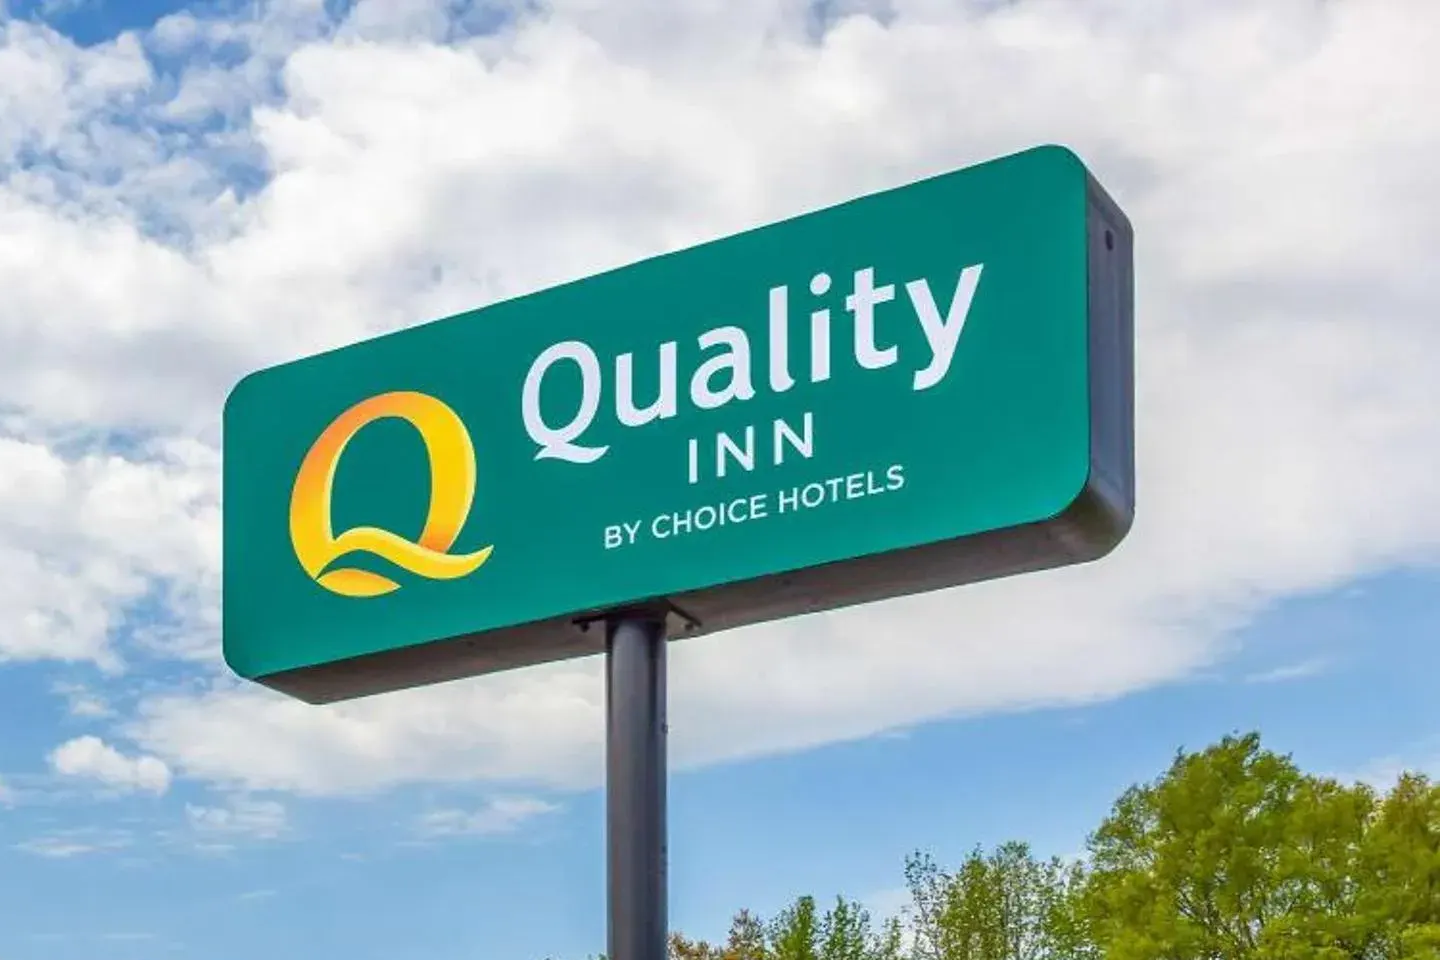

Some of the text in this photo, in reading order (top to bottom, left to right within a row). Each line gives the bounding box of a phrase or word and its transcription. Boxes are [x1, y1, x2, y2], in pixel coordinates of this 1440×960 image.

[521, 263, 984, 464] Quality
[289, 390, 494, 598] Q
[605, 465, 904, 549] BY CHOICE HOTELS
[688, 412, 814, 484] INN
